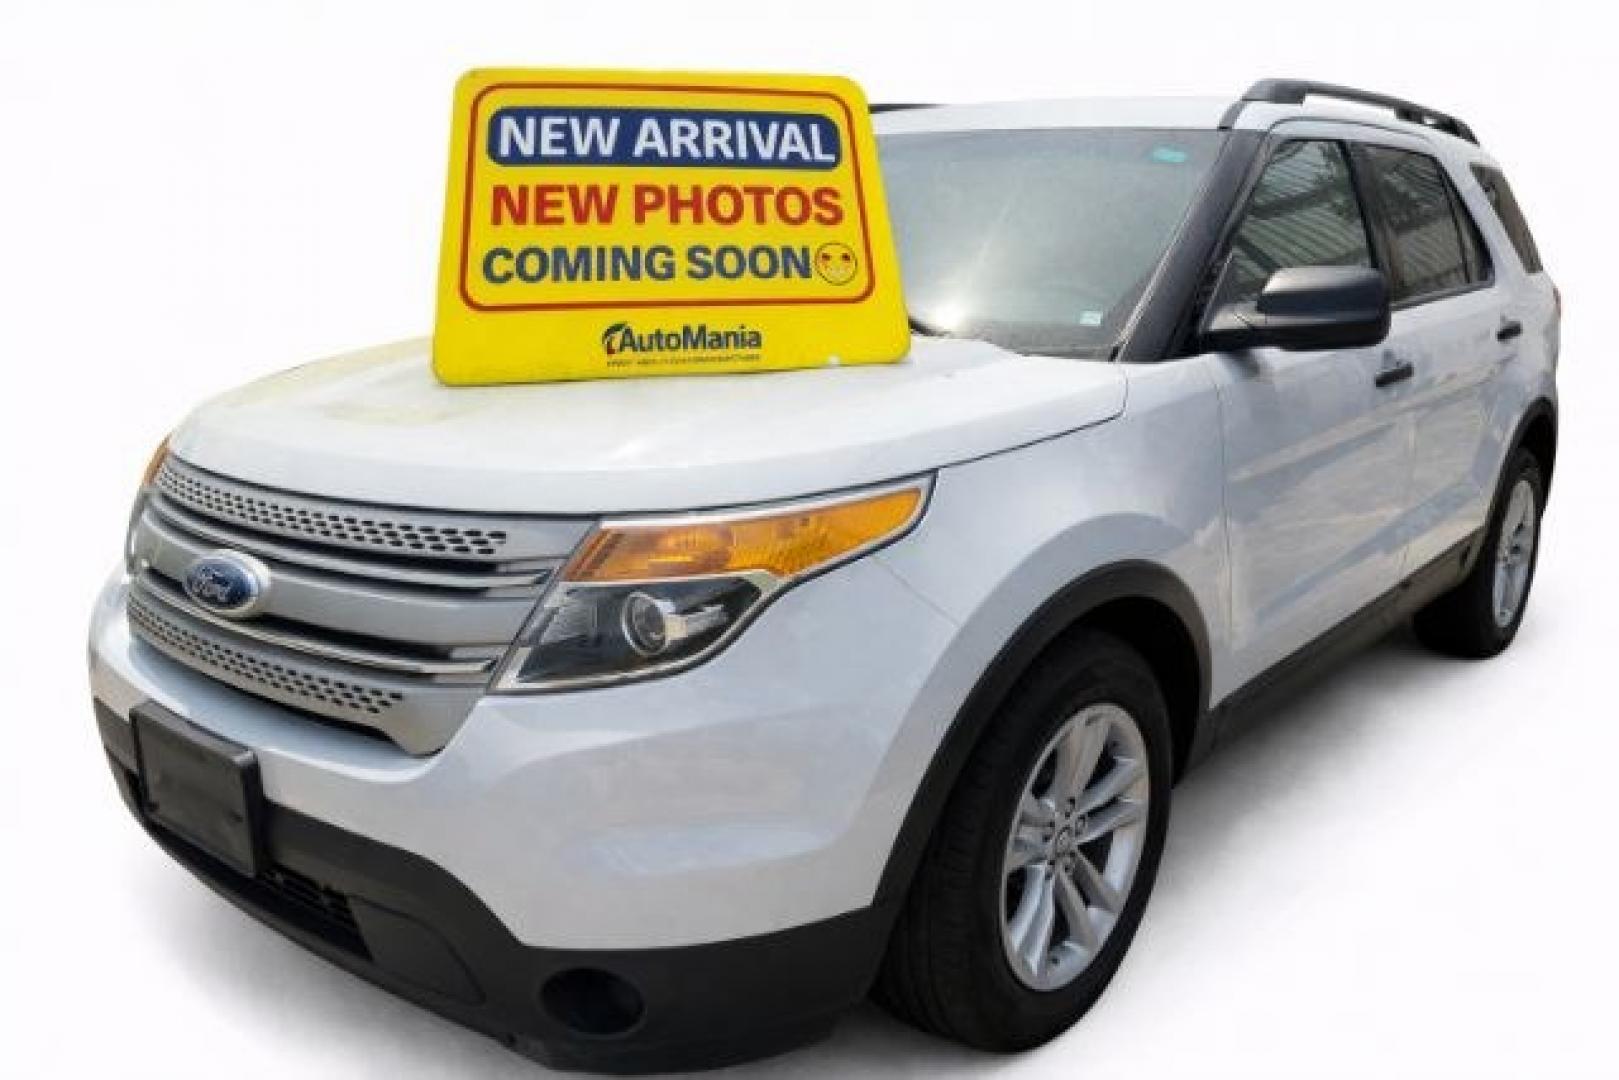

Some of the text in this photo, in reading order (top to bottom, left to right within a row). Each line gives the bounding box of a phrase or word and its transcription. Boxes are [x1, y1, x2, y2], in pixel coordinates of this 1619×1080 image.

[499, 117, 836, 163] NEW ARRIVAL
[490, 184, 844, 226] NEW PHOTOS
[482, 245, 812, 284] COMING SOON
[619, 324, 762, 352] AutoMania
